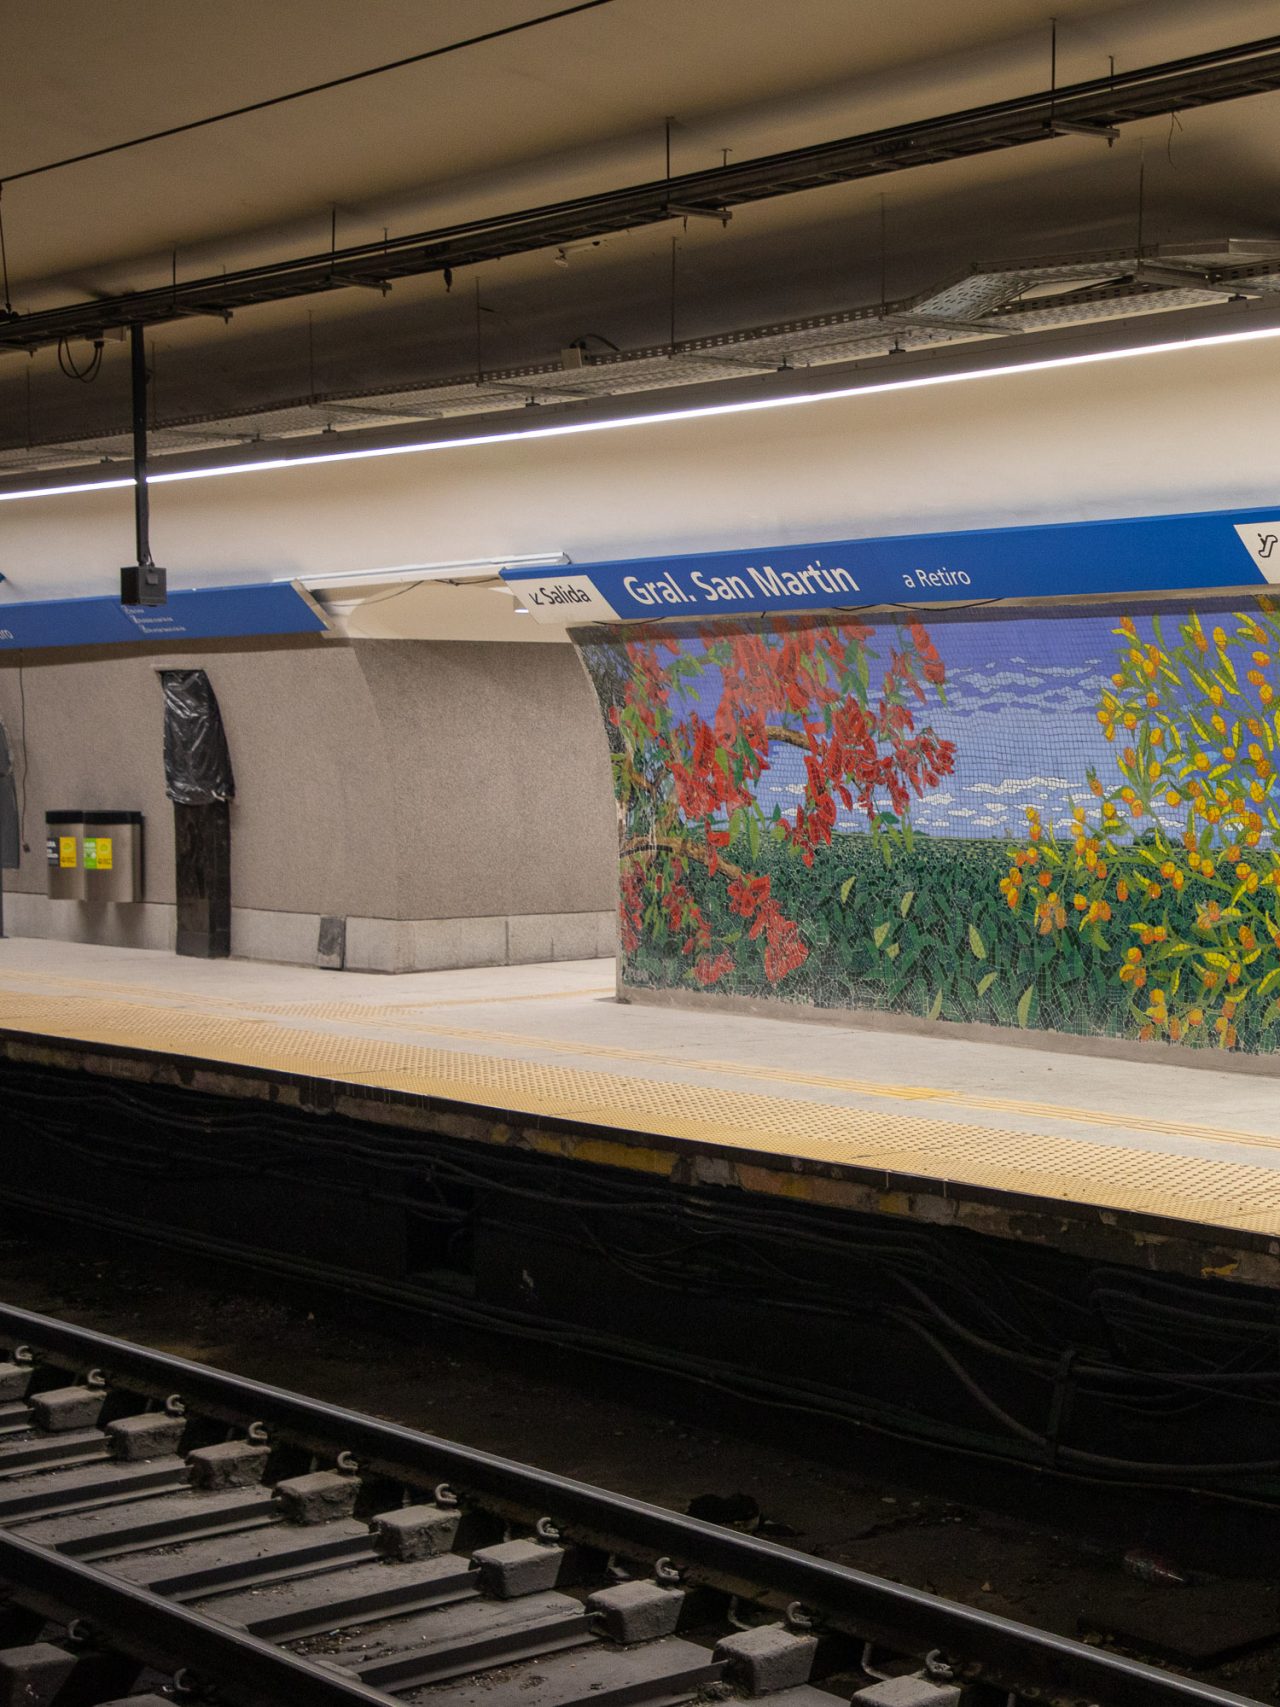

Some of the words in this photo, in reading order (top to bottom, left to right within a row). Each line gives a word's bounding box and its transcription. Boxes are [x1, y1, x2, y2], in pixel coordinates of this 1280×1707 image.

[623, 571, 698, 606] Gral.
[690, 570, 755, 601] San
[746, 560, 861, 598] Martín
[902, 573, 916, 589] a
[914, 566, 971, 587] Retiro
[539, 584, 592, 606] Salida
